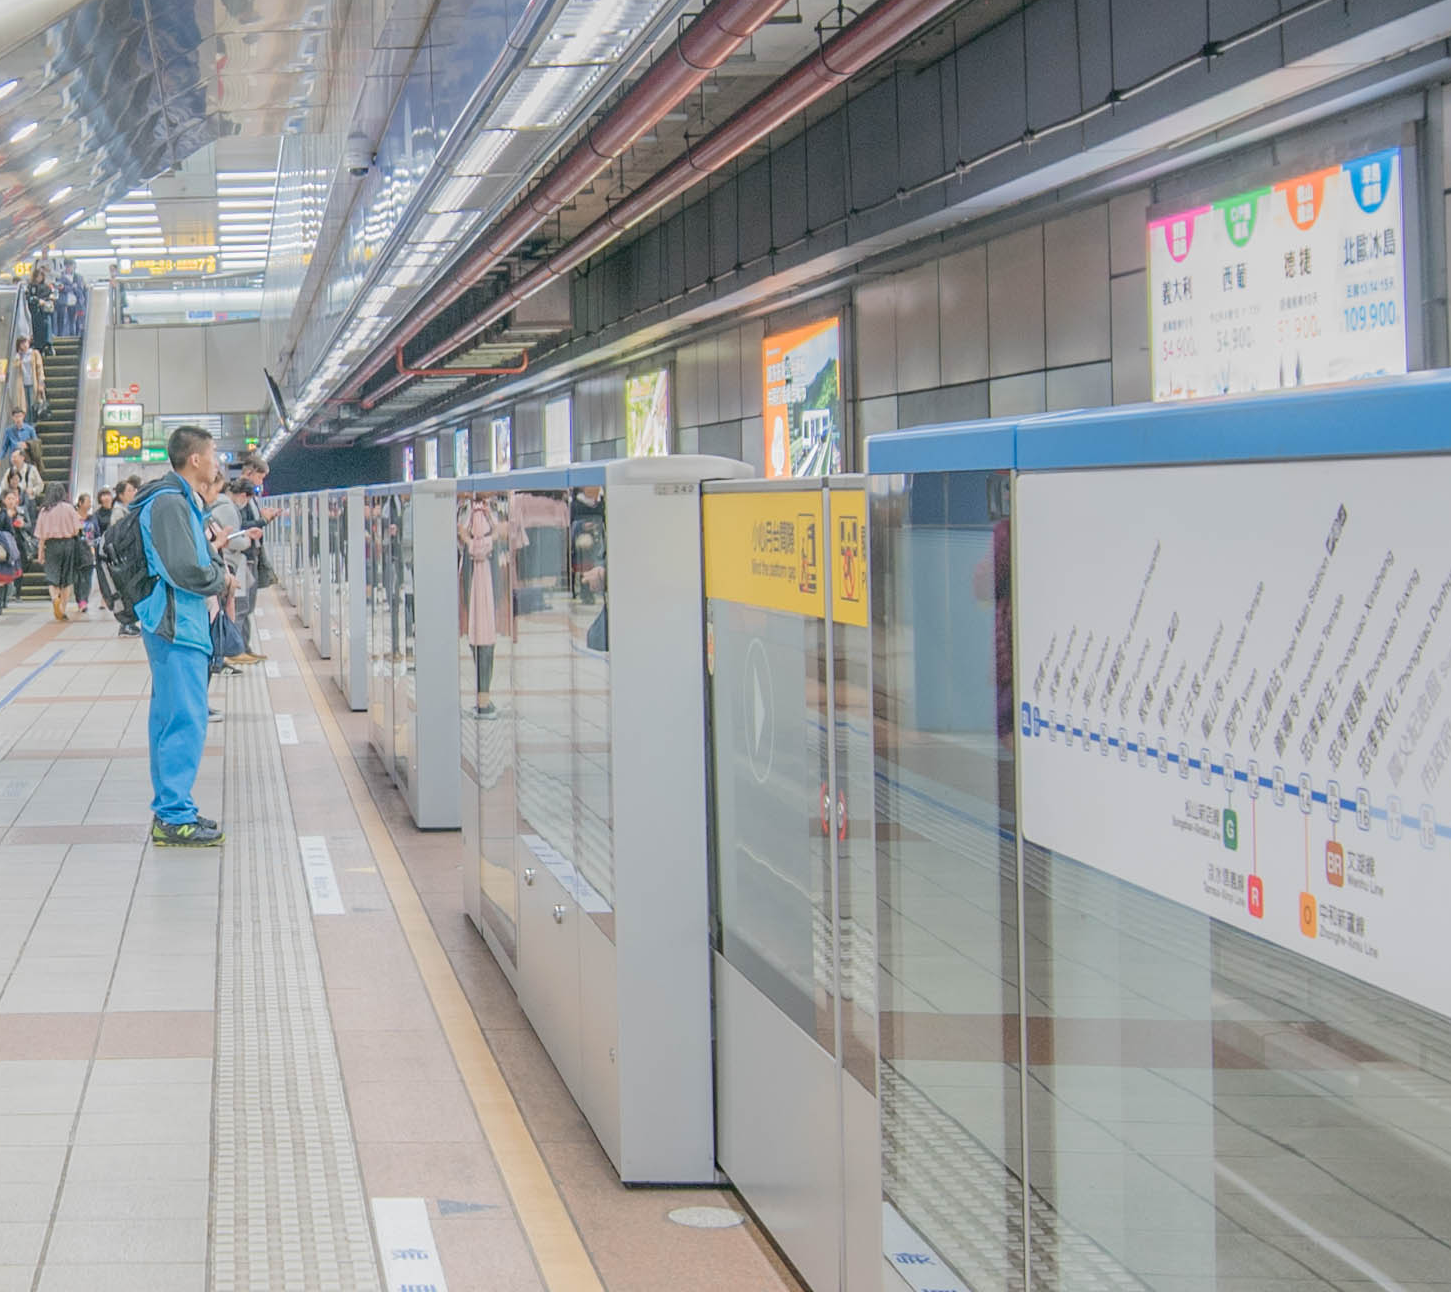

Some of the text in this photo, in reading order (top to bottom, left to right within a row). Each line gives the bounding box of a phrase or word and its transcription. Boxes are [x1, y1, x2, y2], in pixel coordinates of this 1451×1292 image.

[1343, 228, 1396, 266] 北歐冰島
[1162, 276, 1193, 306] 義大利
[1397, 621, 1432, 695] Zhongxiao
[1226, 822, 1235, 839] G
[1327, 852, 1342, 877] BR
[1251, 888, 1259, 906] R
